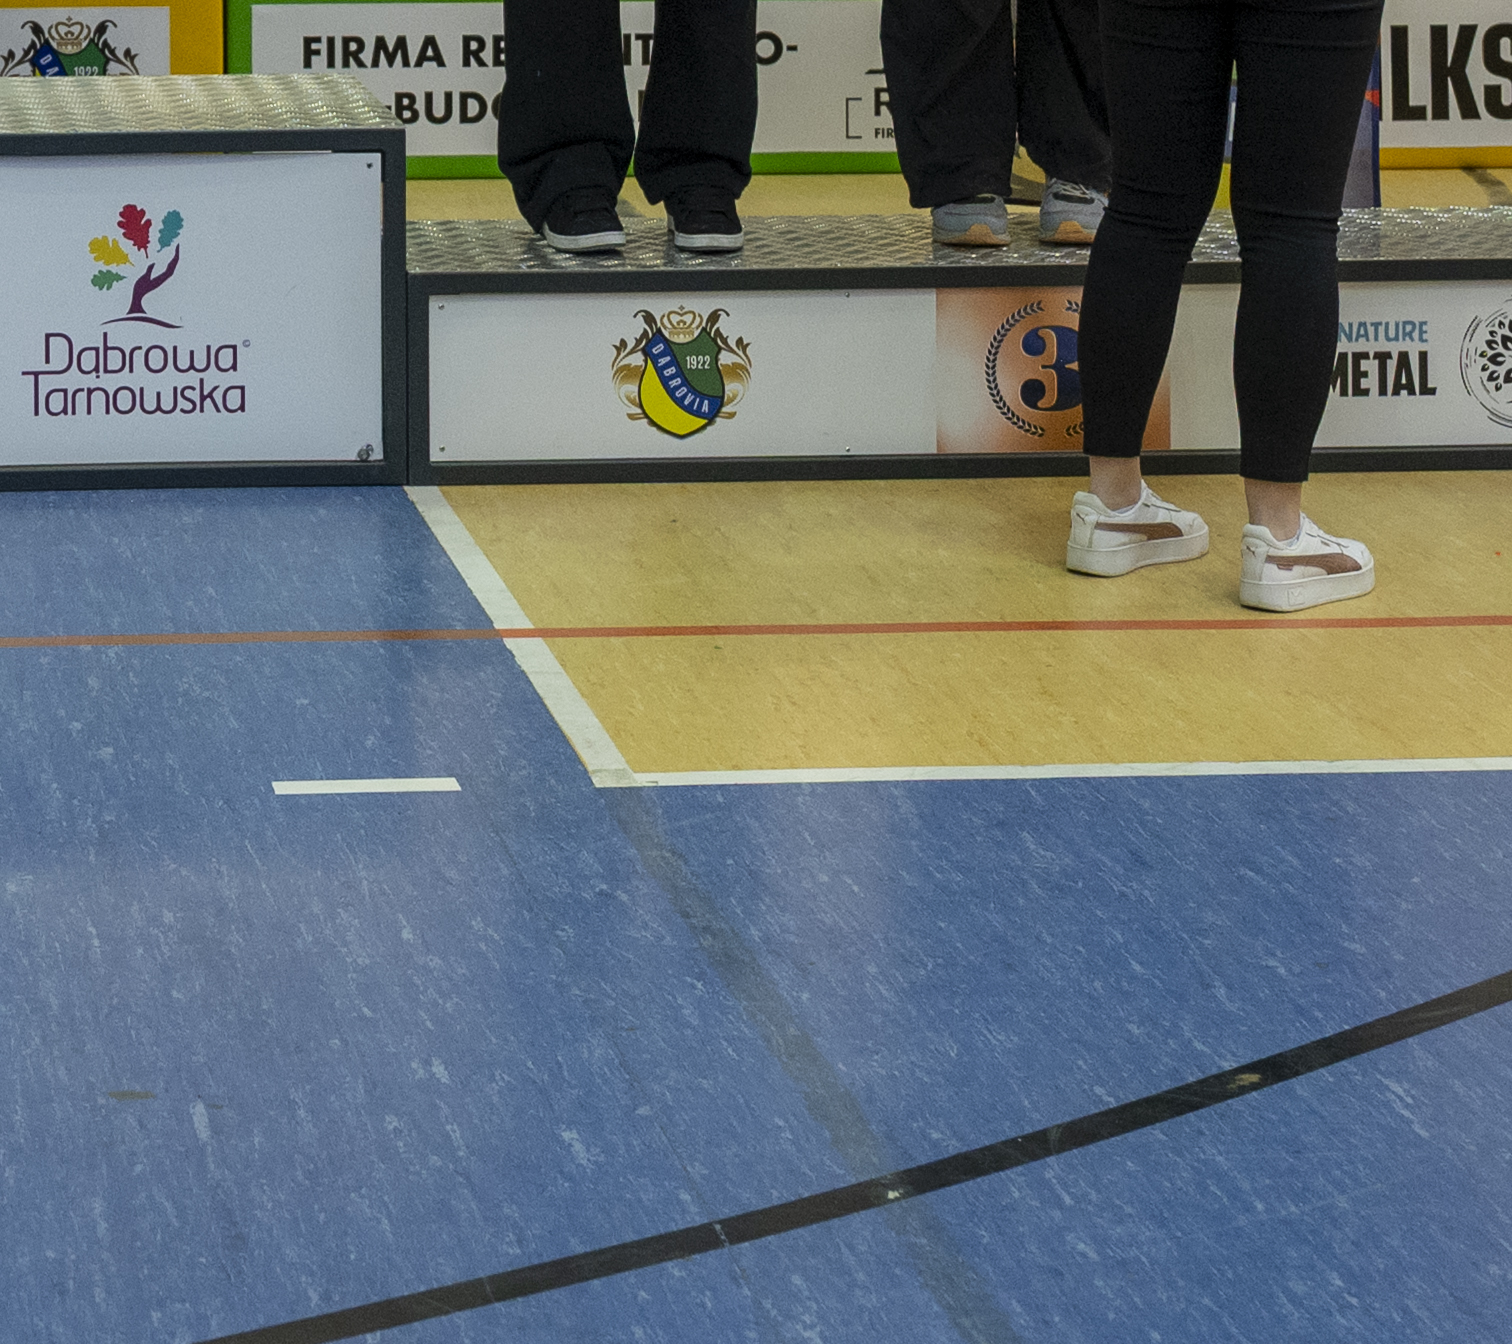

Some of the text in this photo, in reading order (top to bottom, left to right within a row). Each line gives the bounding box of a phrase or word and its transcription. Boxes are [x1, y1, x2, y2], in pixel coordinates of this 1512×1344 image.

[302, 34, 447, 70] FIRMA
[42, 329, 242, 379] Dąbrowa
[1337, 319, 1429, 344] NATURE
[646, 339, 714, 417] DĄBROVIA
[684, 353, 714, 372] 1922
[1018, 324, 1083, 412] 3
[20, 368, 249, 417] Tarnowska
